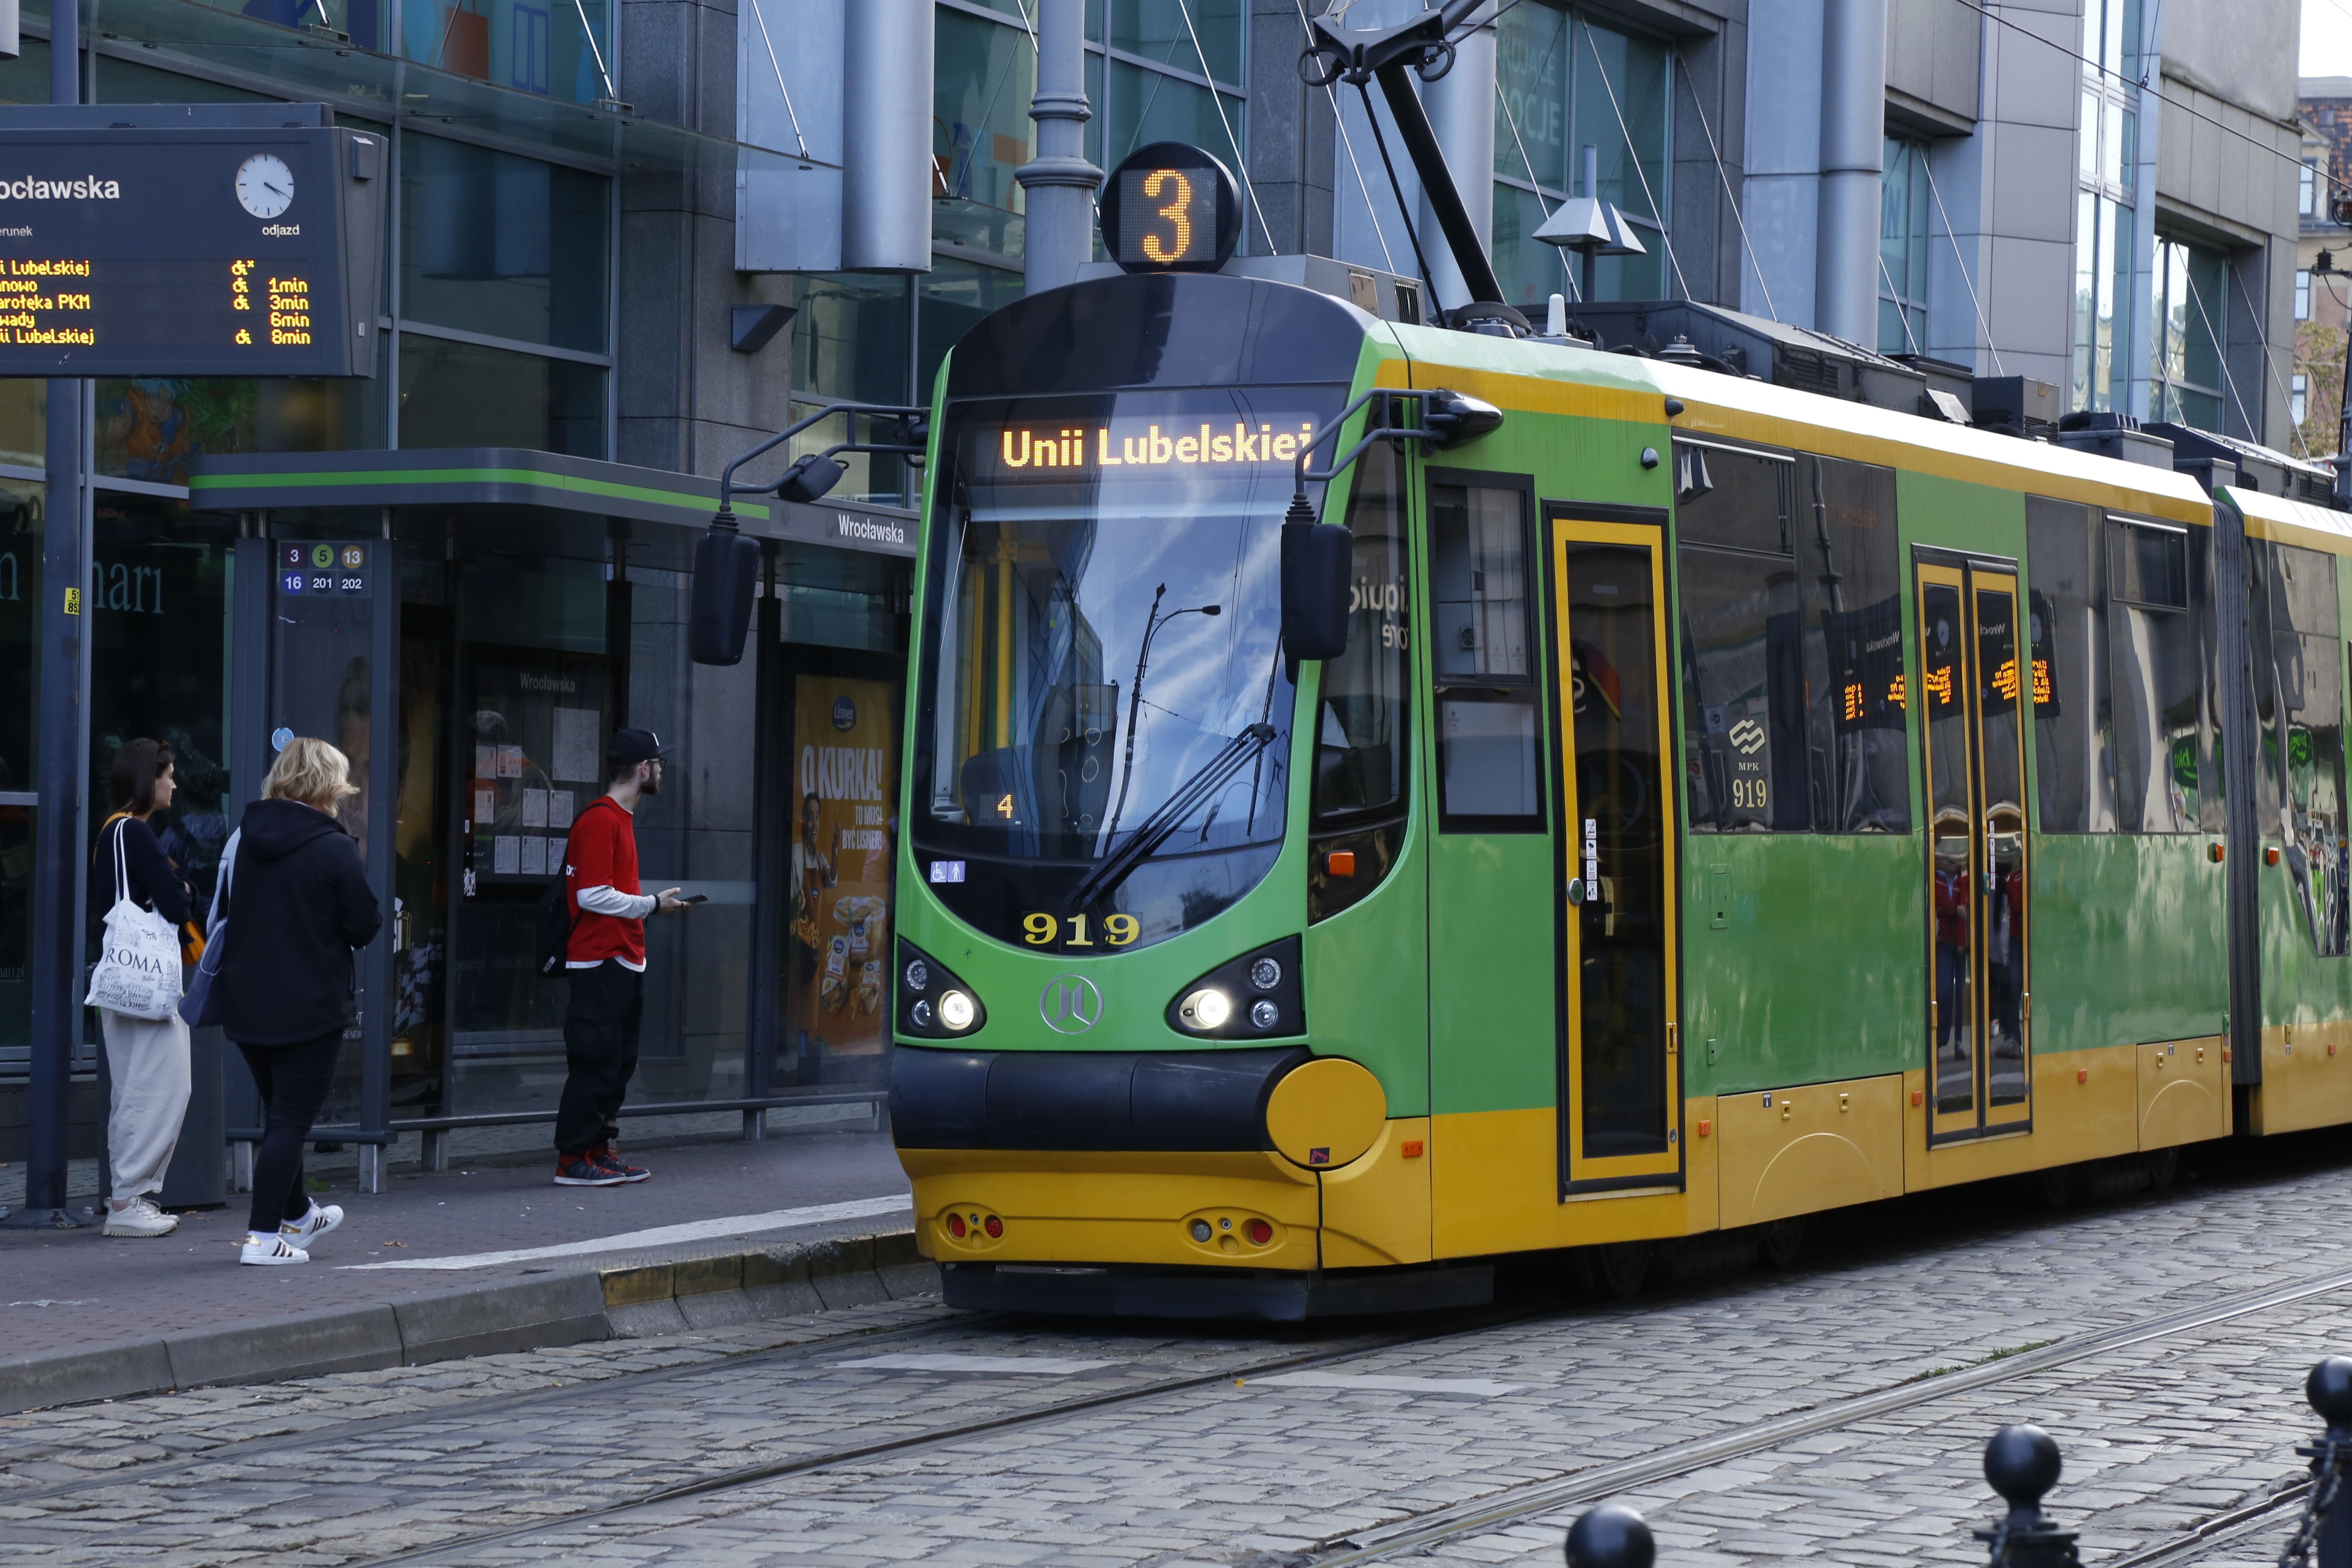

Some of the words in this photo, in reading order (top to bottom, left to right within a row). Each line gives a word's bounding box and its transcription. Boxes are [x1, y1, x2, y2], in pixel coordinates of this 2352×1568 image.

[1143, 168, 1191, 262] 3
[262, 224, 300, 238] odjazd
[11, 259, 90, 277] Lubelskiej
[269, 277, 308, 293] 1min
[58, 294, 90, 309] PKM
[270, 294, 309, 310] 3min
[270, 312, 310, 327] 6min
[16, 328, 94, 346] Lubelskiej
[271, 329, 311, 344] 8min
[1003, 429, 1082, 468] Unii
[1098, 423, 1311, 470] Lubelskiej
[839, 514, 903, 544] Wrocławska
[290, 549, 299, 562] 3
[319, 550, 327, 562] 5
[344, 551, 360, 564] 13
[285, 576, 301, 589] 16
[313, 578, 332, 588] 201
[342, 579, 362, 589] 202
[520, 672, 575, 692] Wrocławska
[834, 704, 854, 720] Lisner
[801, 744, 815, 797] O
[818, 746, 883, 801] KURKA!
[1738, 763, 1759, 771] MPK
[1733, 778, 1767, 808] 919
[855, 805, 863, 825] TO
[996, 793, 1013, 819] 4
[842, 825, 855, 850] BYĆ
[857, 830, 882, 850] LISNER!
[1023, 913, 1139, 946] 919
[105, 947, 162, 974] ROMA
[350, 1030, 362, 1038] NEW
